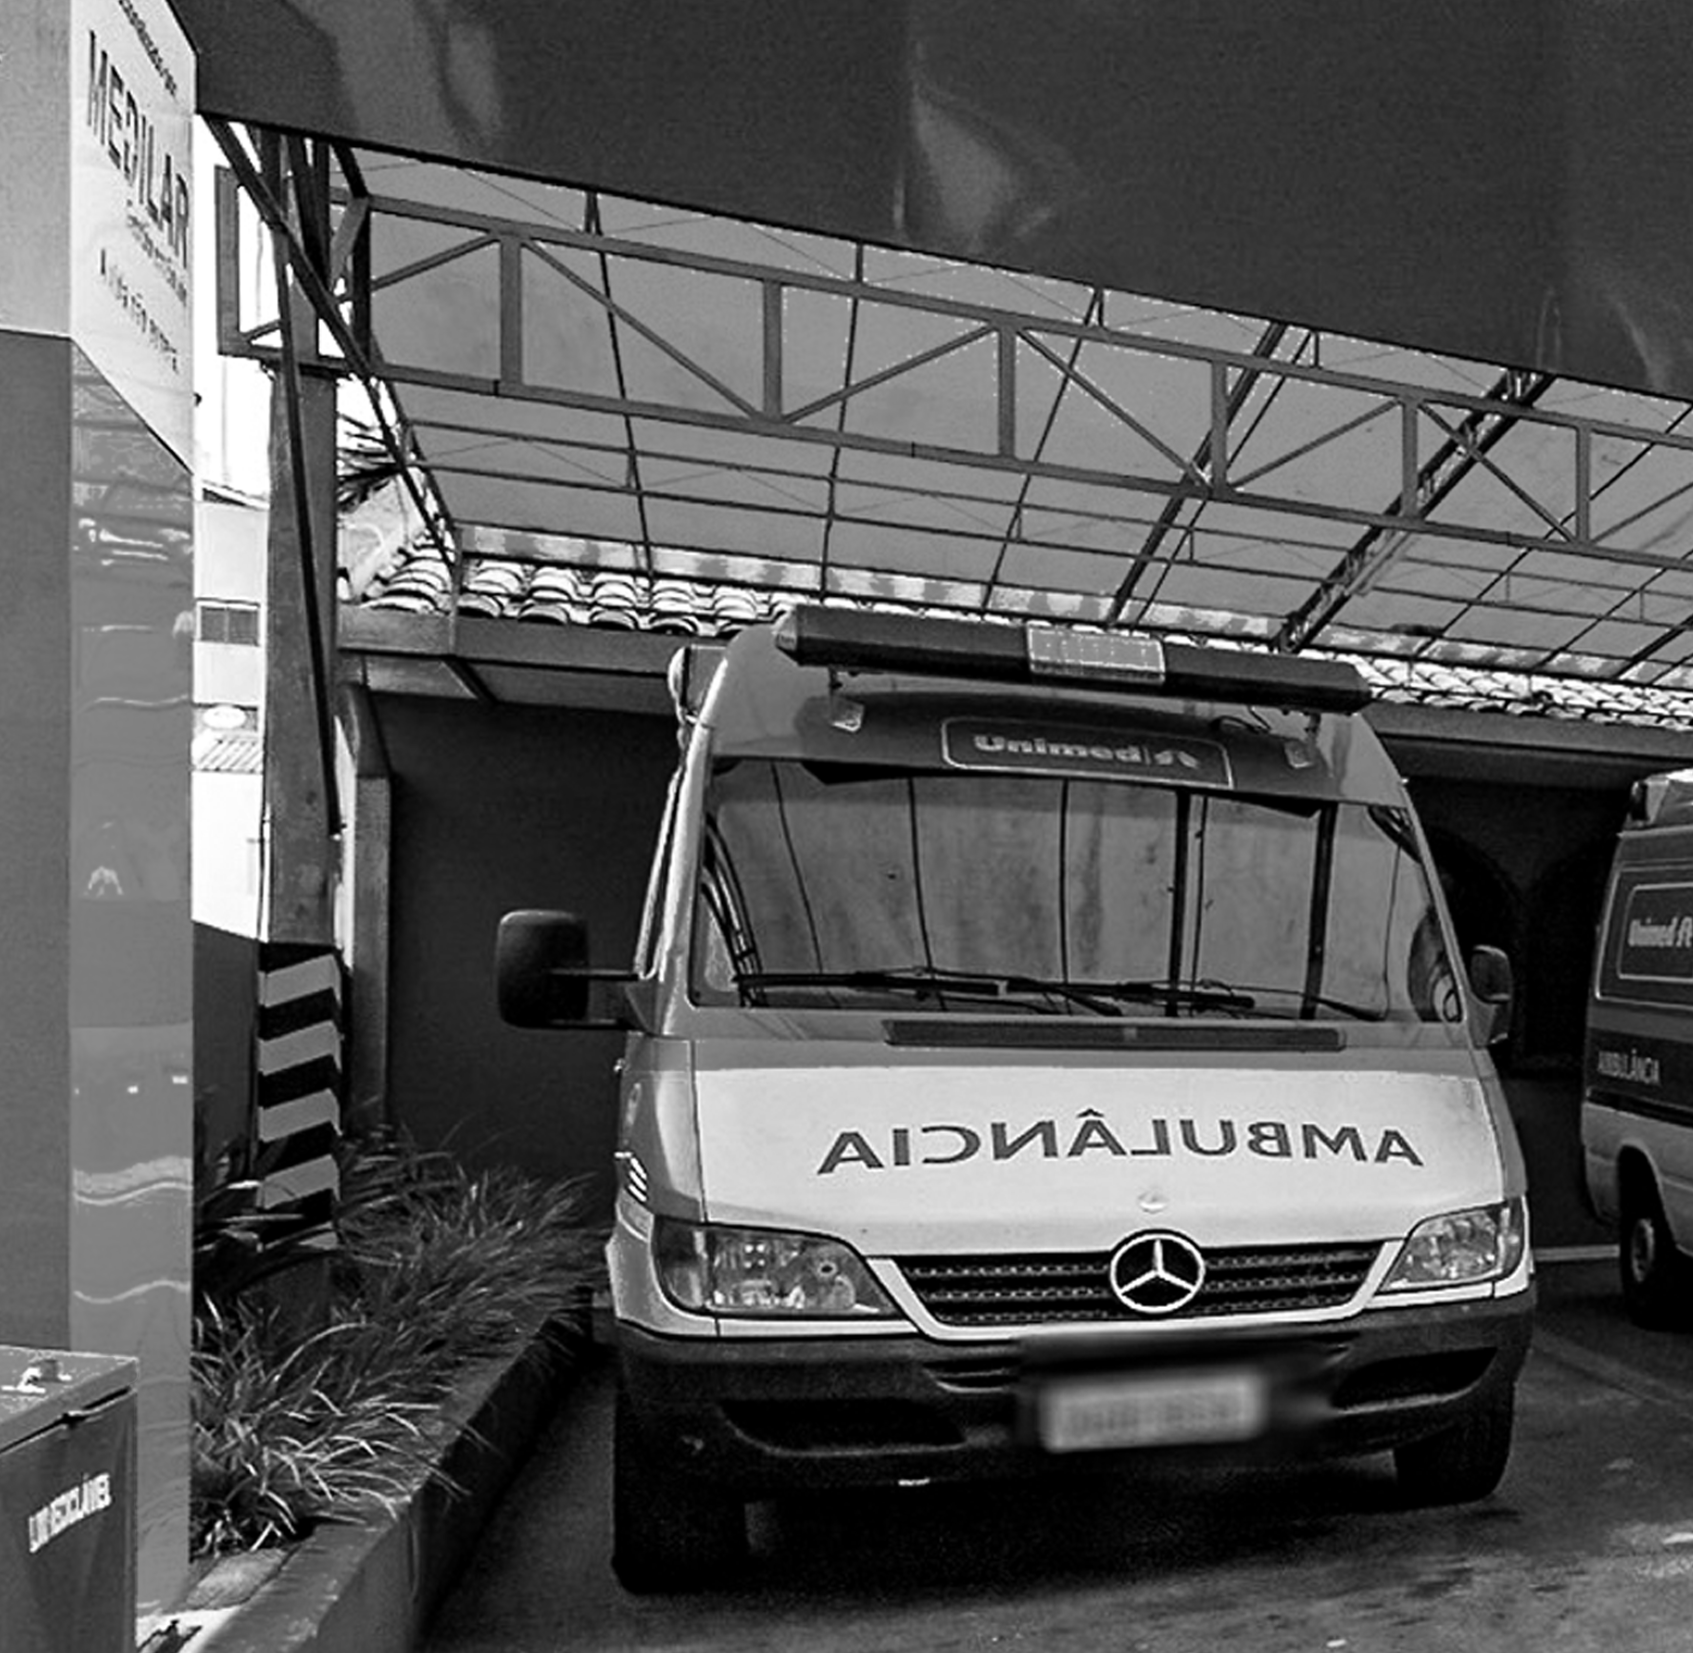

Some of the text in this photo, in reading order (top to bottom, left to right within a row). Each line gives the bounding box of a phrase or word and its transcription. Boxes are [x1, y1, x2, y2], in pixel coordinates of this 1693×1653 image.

[87, 29, 189, 269] MEDILAR
[974, 735, 1142, 763] Unimed
[1628, 917, 1679, 947] Unimed
